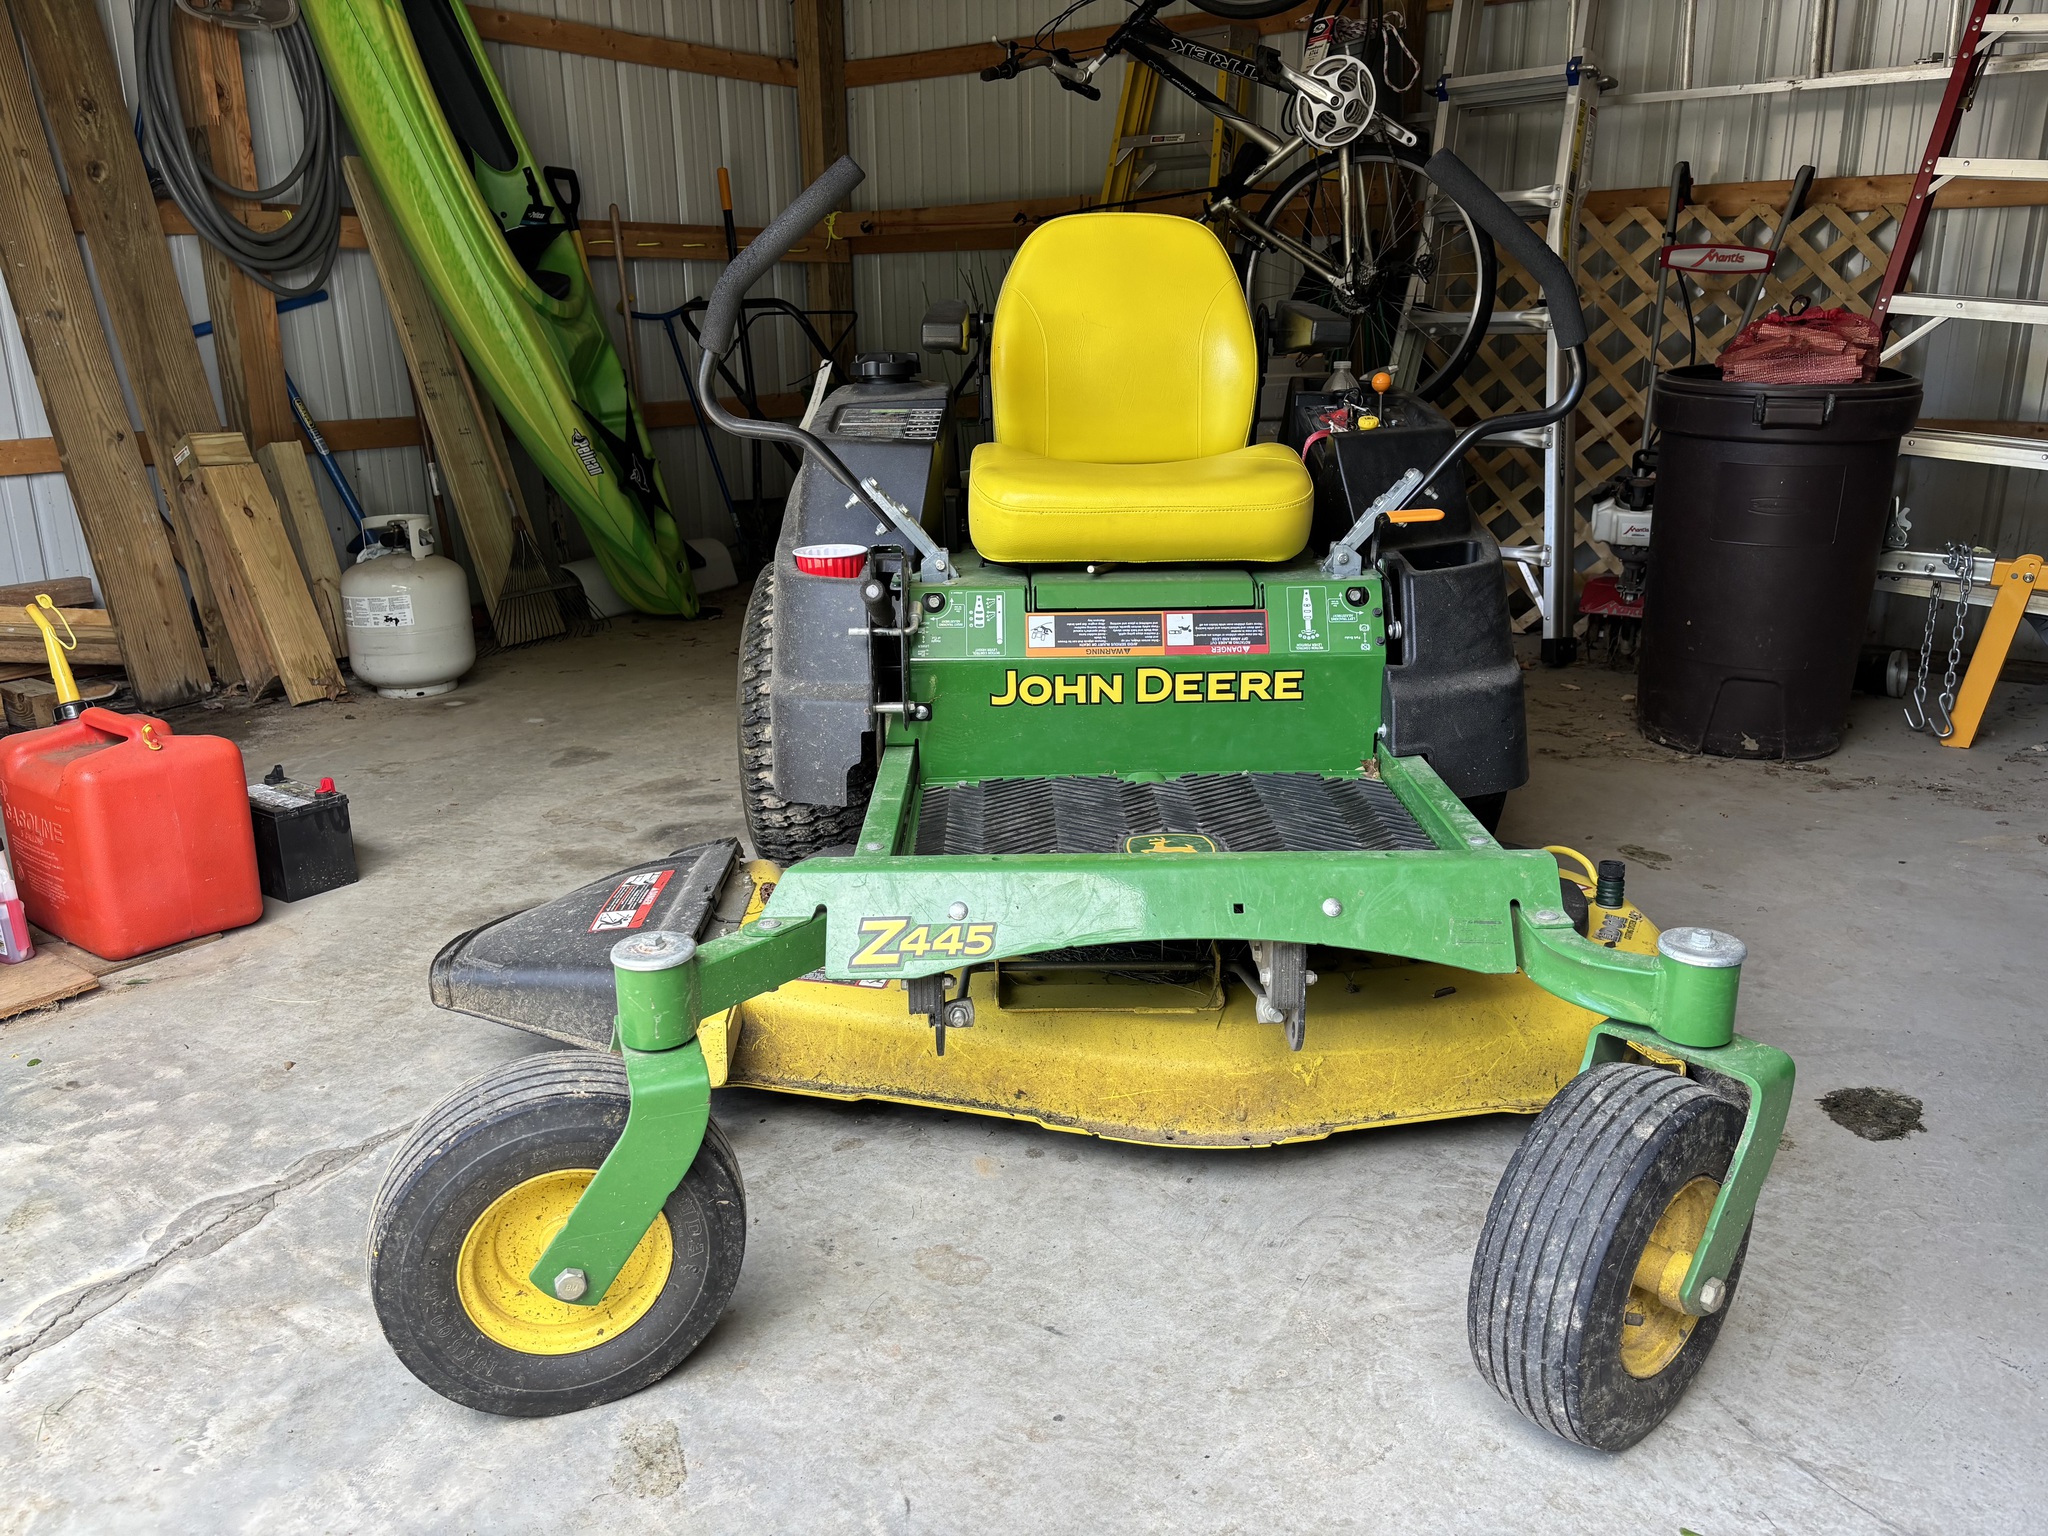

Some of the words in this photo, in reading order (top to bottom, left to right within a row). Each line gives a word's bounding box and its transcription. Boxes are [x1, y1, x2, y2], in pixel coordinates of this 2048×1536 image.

[1169, 38, 1259, 81] TREK
[531, 211, 545, 219] Pelican
[1690, 248, 1745, 267] Mantis
[574, 435, 604, 476] Pelican
[1623, 525, 1649, 535] Mantis
[990, 668, 1124, 706] JOHN
[1136, 667, 1304, 703] DEERE
[6, 803, 64, 844] GASOLINE
[849, 916, 997, 971] Z445
